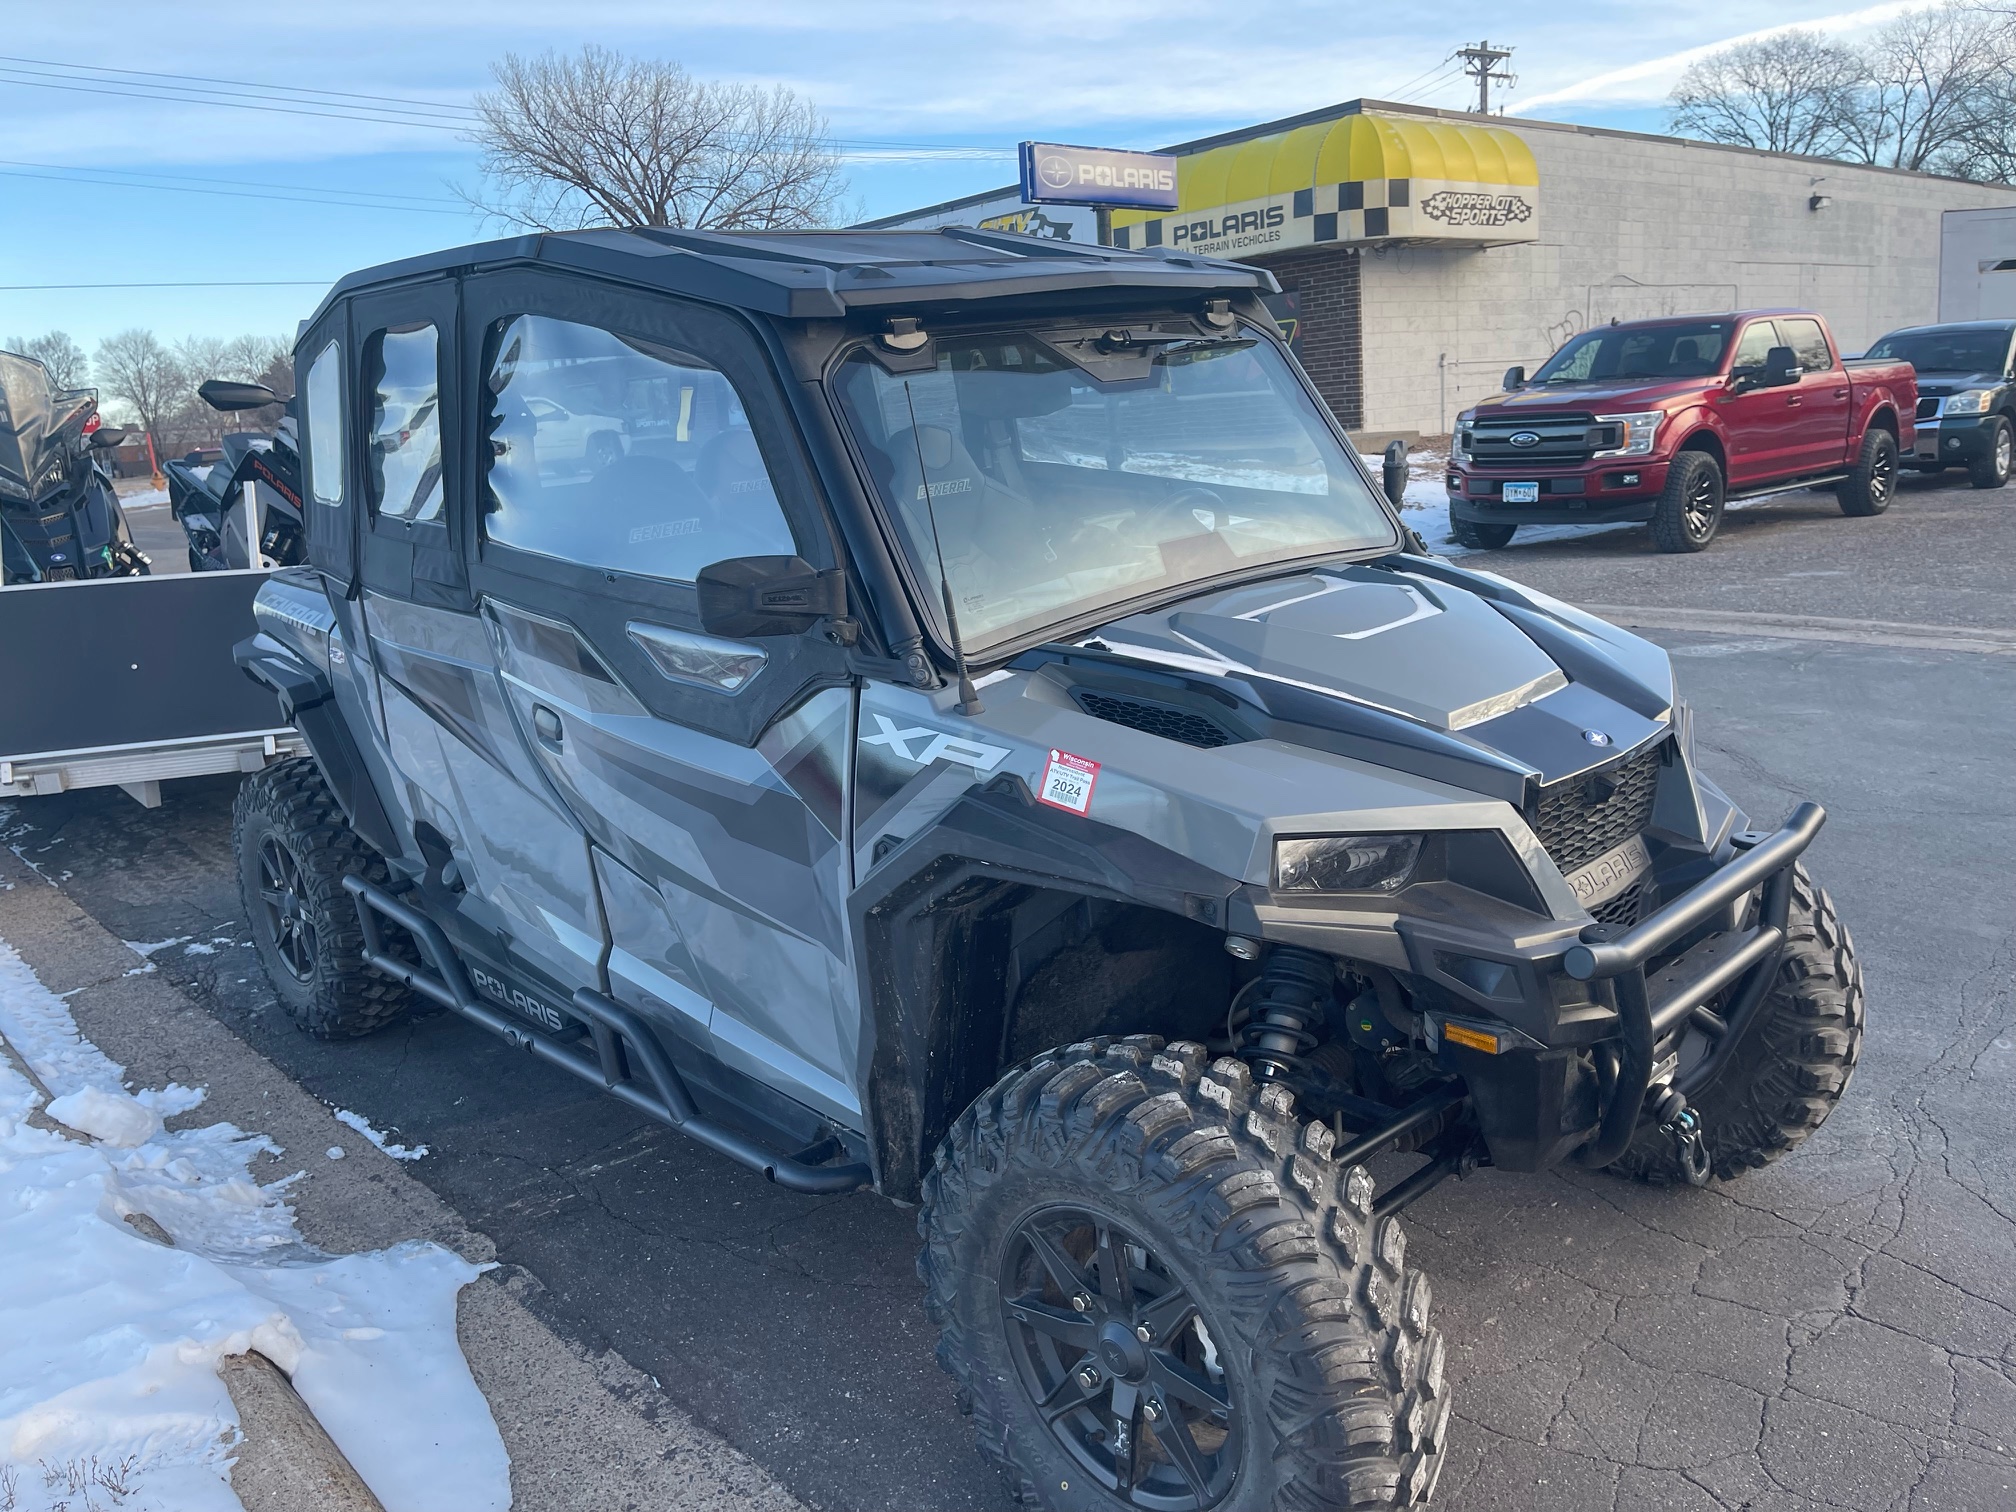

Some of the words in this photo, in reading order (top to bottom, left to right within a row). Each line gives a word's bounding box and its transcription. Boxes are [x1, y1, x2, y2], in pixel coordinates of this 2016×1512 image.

[1078, 164, 1174, 191] POLARIS
[1449, 208, 1507, 225] SPORTS
[1495, 196, 1519, 211] CITY
[1173, 205, 1285, 246] POLARIS
[1193, 240, 1229, 255] TERRAIN
[1231, 230, 1281, 249] VECHICLES
[254, 459, 302, 509] POLARIS
[730, 478, 771, 494] GENER
[917, 478, 972, 500] GENERAL
[629, 518, 702, 544] GENERAL
[257, 593, 325, 636] GENERAL
[859, 713, 1012, 772] XP
[1063, 753, 1095, 769] Wisconsin
[1052, 778, 1082, 798] 2024
[1567, 844, 1644, 900] OLARIS
[473, 967, 563, 1031] POLARIS
